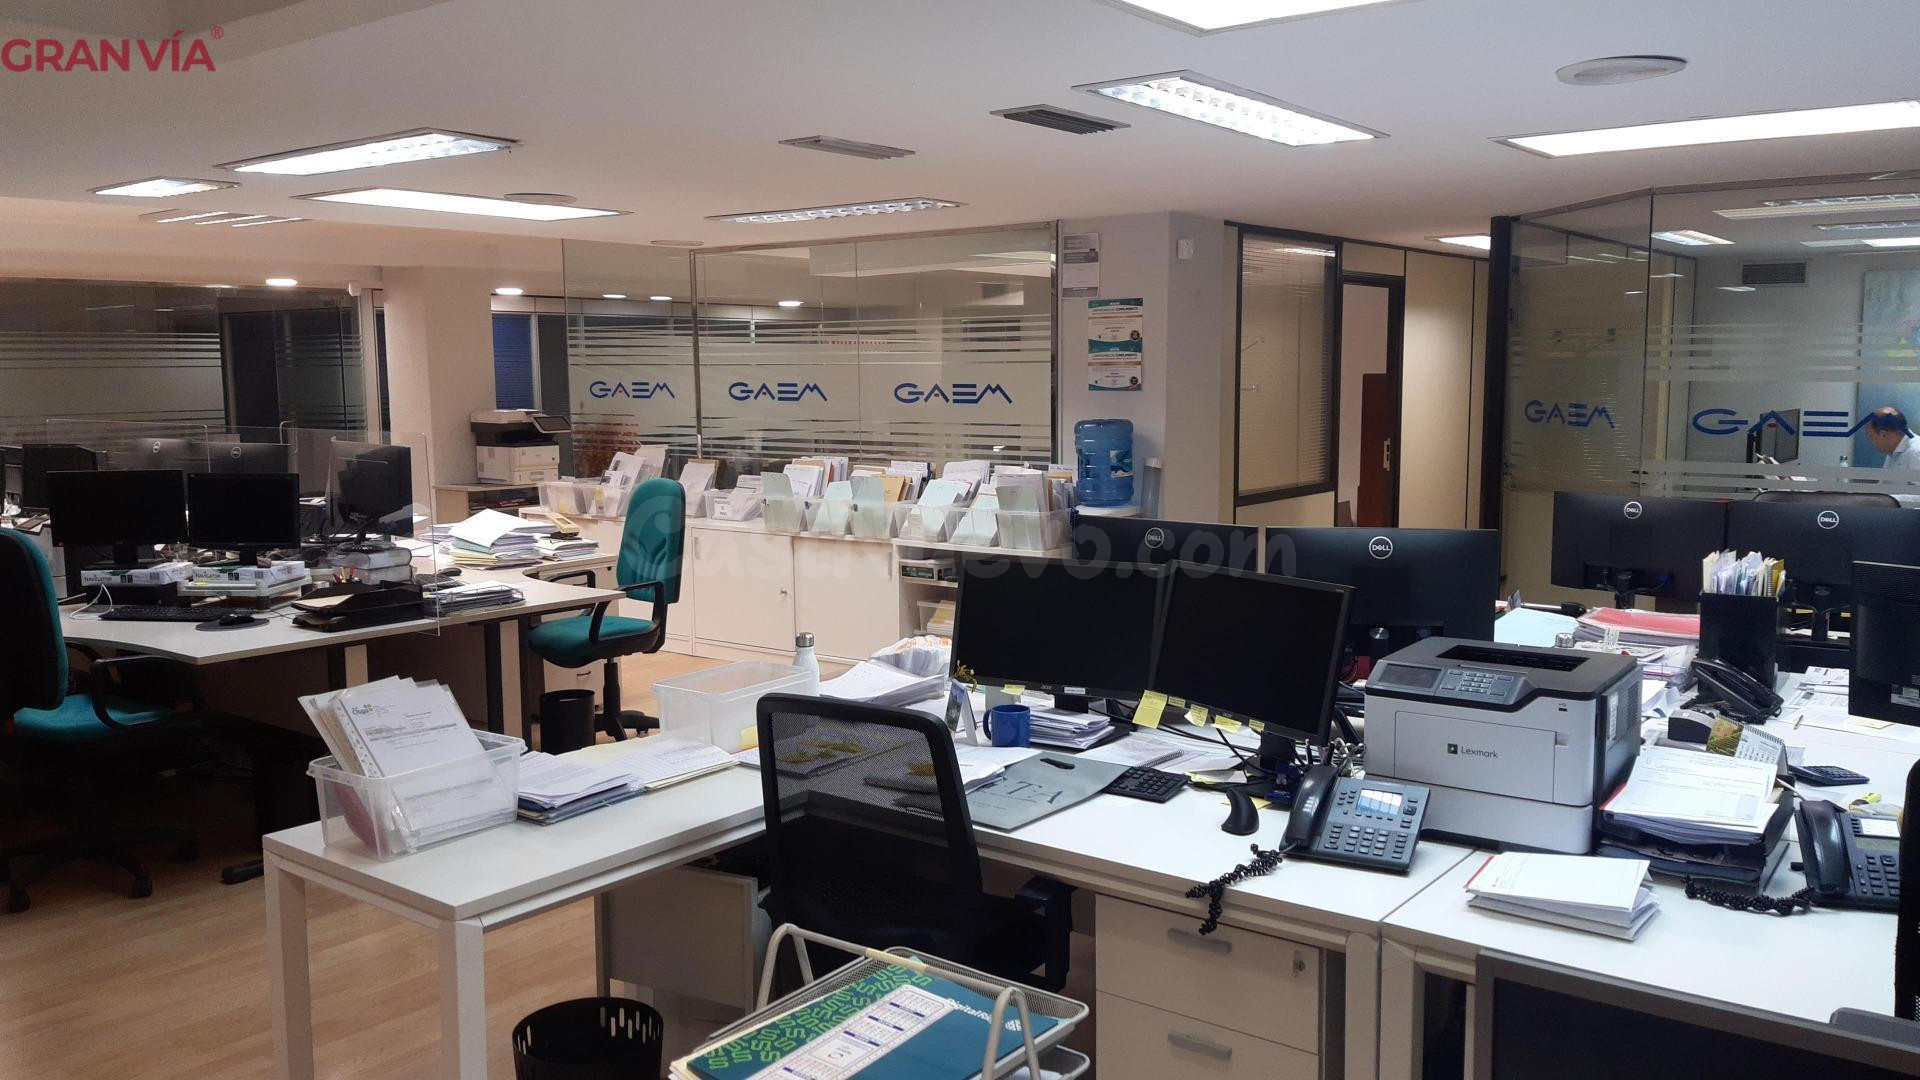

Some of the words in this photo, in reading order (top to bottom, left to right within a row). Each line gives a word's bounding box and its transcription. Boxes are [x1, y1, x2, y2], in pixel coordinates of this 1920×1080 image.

[589, 380, 675, 399] GAEM
[728, 382, 827, 401] GAEM
[894, 382, 1013, 404] GAEM
[1525, 400, 1615, 429] GAEM
[1692, 408, 1914, 439] GAEM
[1461, 745, 1499, 758] Lexmark
